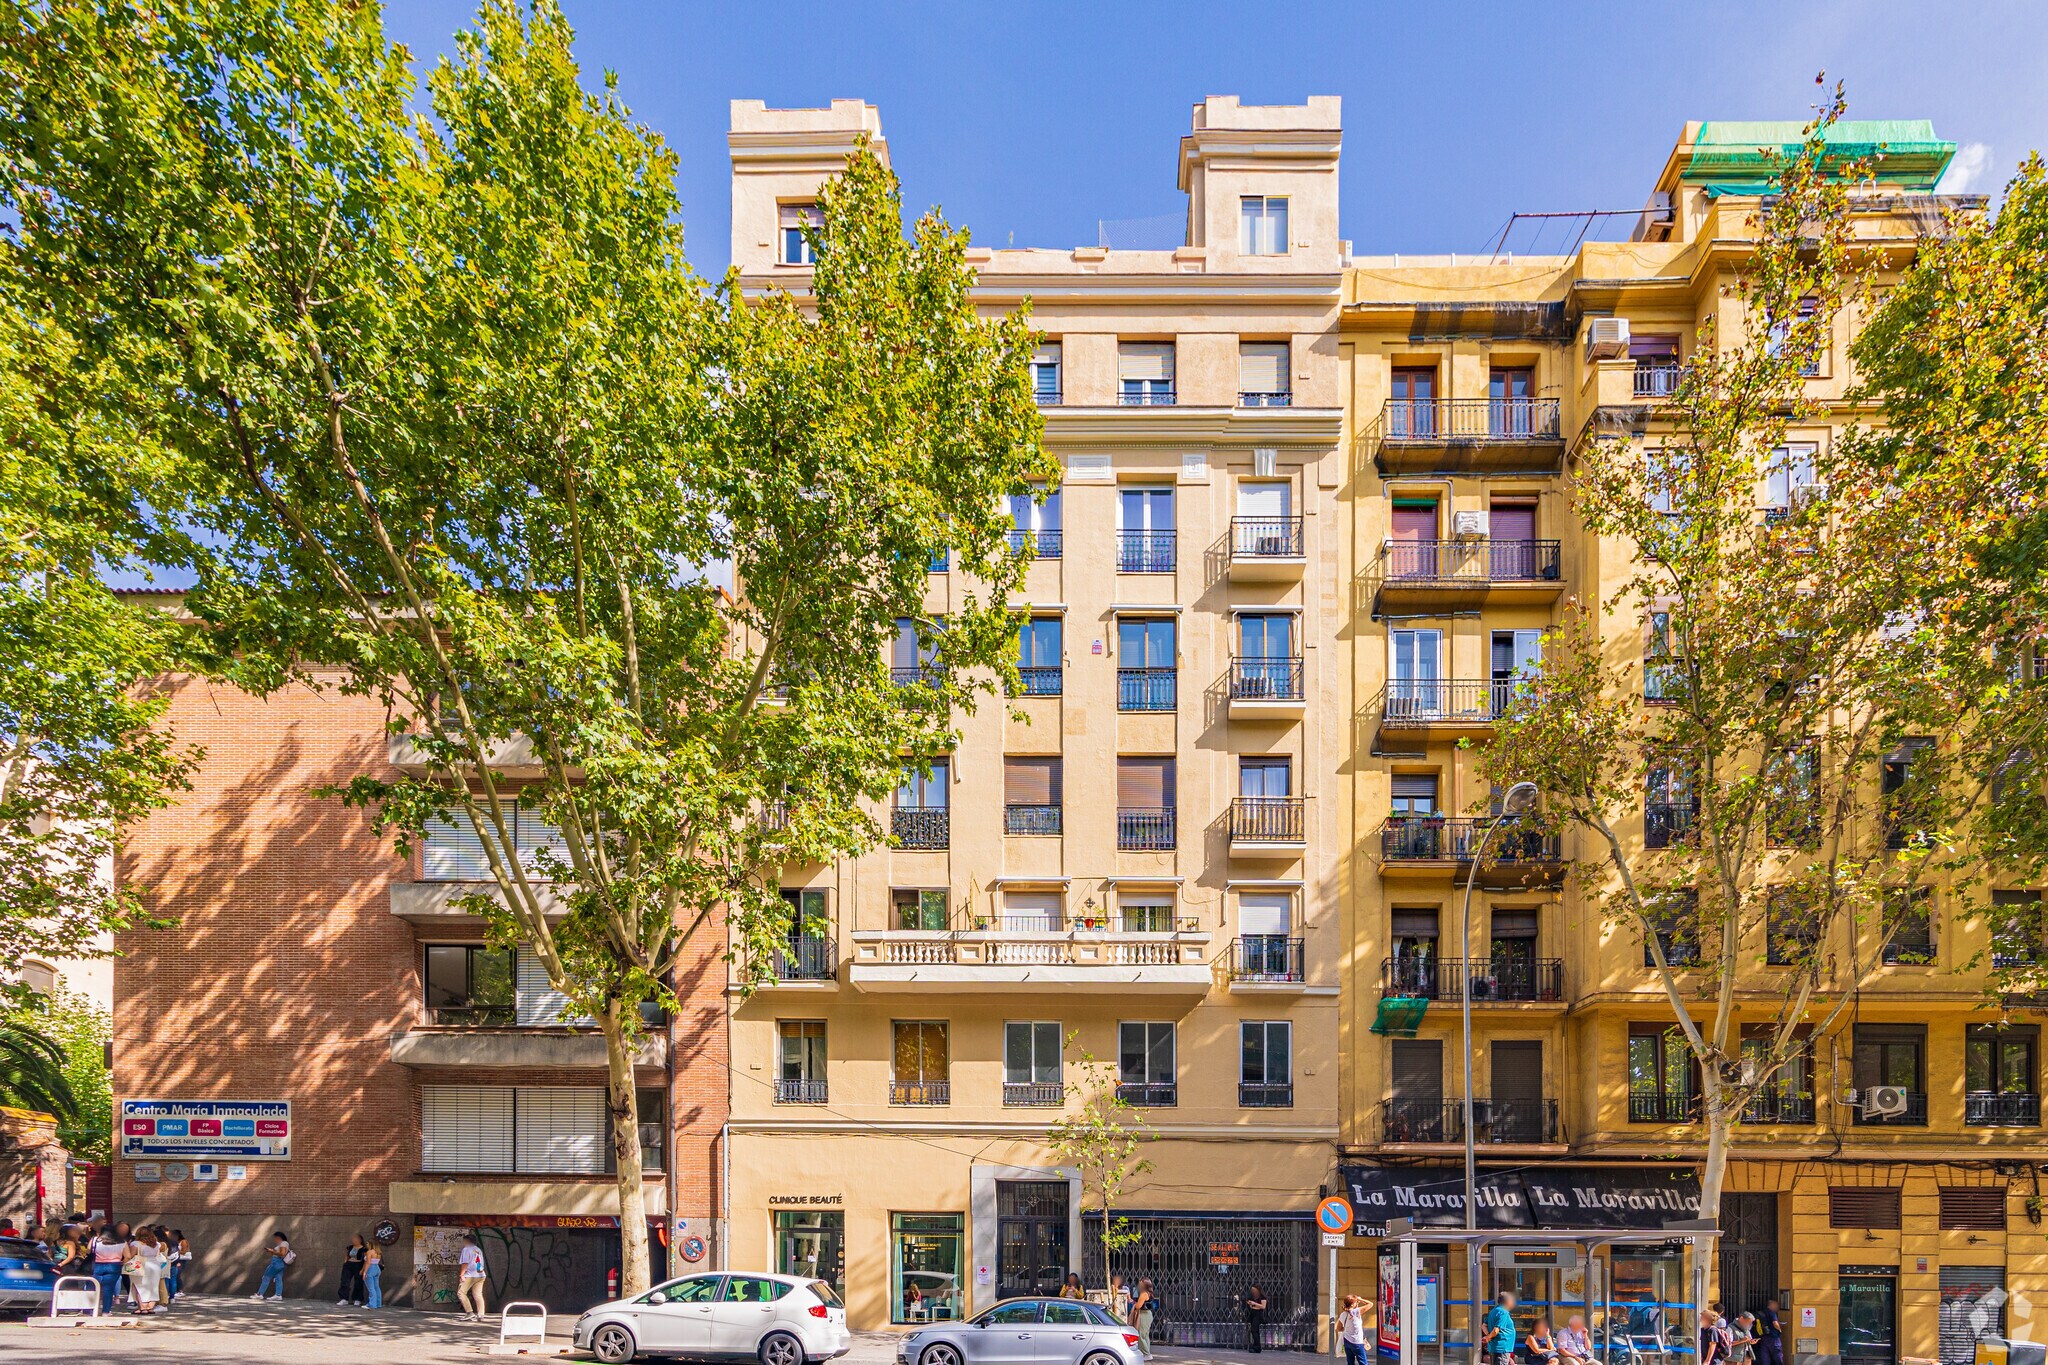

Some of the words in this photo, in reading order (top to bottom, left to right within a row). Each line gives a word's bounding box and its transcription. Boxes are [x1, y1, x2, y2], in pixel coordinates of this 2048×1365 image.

[125, 1103, 168, 1115] Centro
[171, 1104, 208, 1116] María
[212, 1104, 287, 1117] Inmaculada
[132, 1123, 147, 1131] ESO
[769, 1195, 808, 1204] CLINIQUE
[809, 1193, 843, 1204] BEAUTÉ
[1352, 1184, 1387, 1206] La
[1532, 1186, 1570, 1207] La
[1572, 1187, 1700, 1211] Maravilla
[1849, 1284, 1891, 1292] Maravilla
